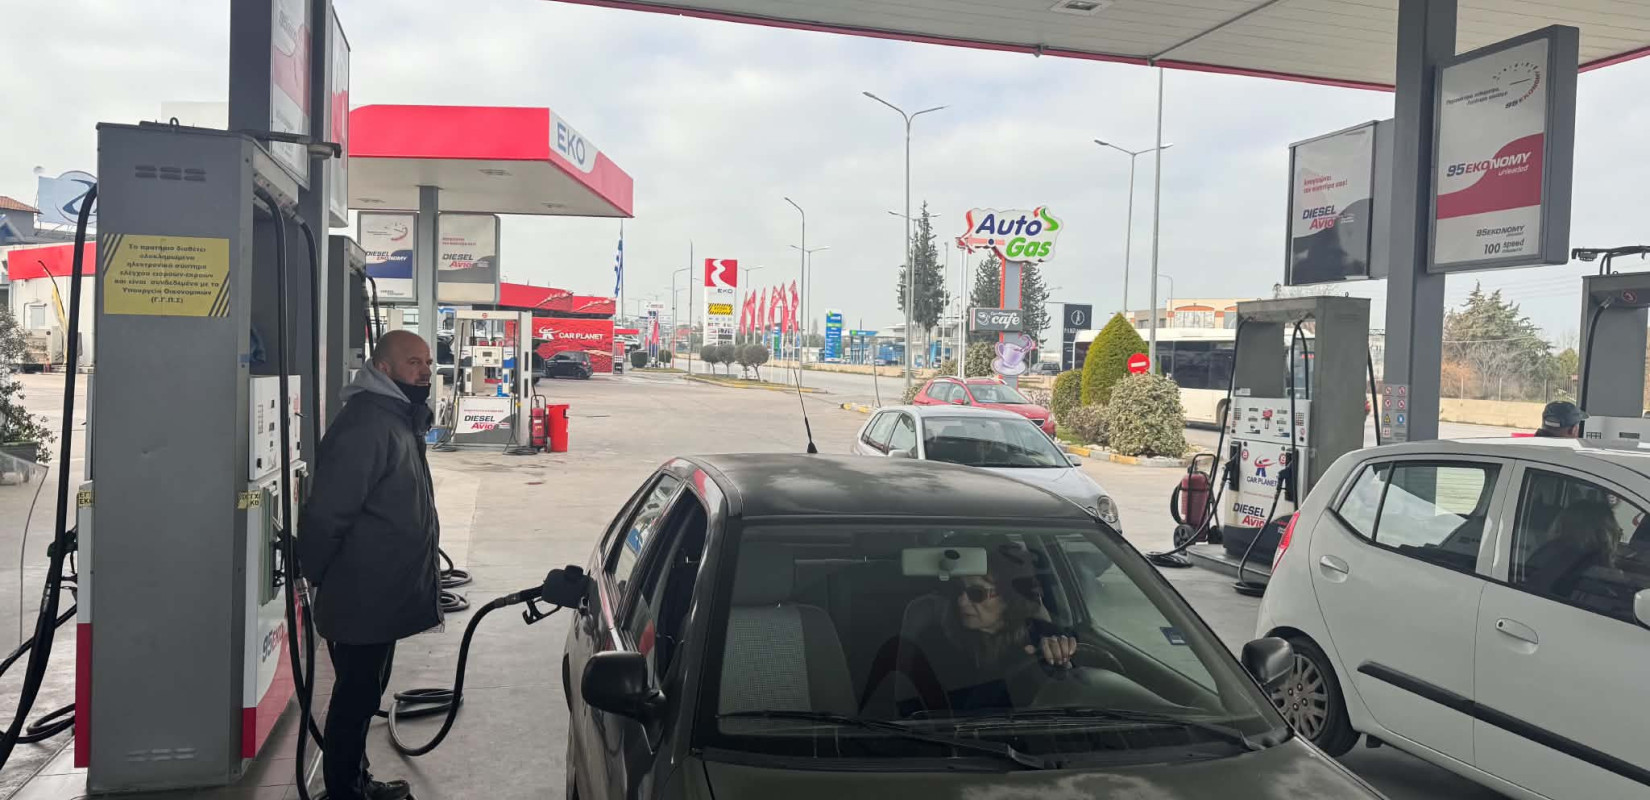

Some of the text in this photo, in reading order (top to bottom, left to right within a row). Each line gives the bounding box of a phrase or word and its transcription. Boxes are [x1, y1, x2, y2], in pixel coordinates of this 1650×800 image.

[557, 121, 586, 165] EKO
[1302, 205, 1336, 219] DIESEL
[975, 213, 1042, 236] Auto
[1005, 237, 1052, 257] Gas
[1484, 243, 1500, 254] 100
[991, 312, 1020, 329] cafe
[1246, 476, 1258, 484] CAR
[1232, 502, 1265, 518] DIESEL
